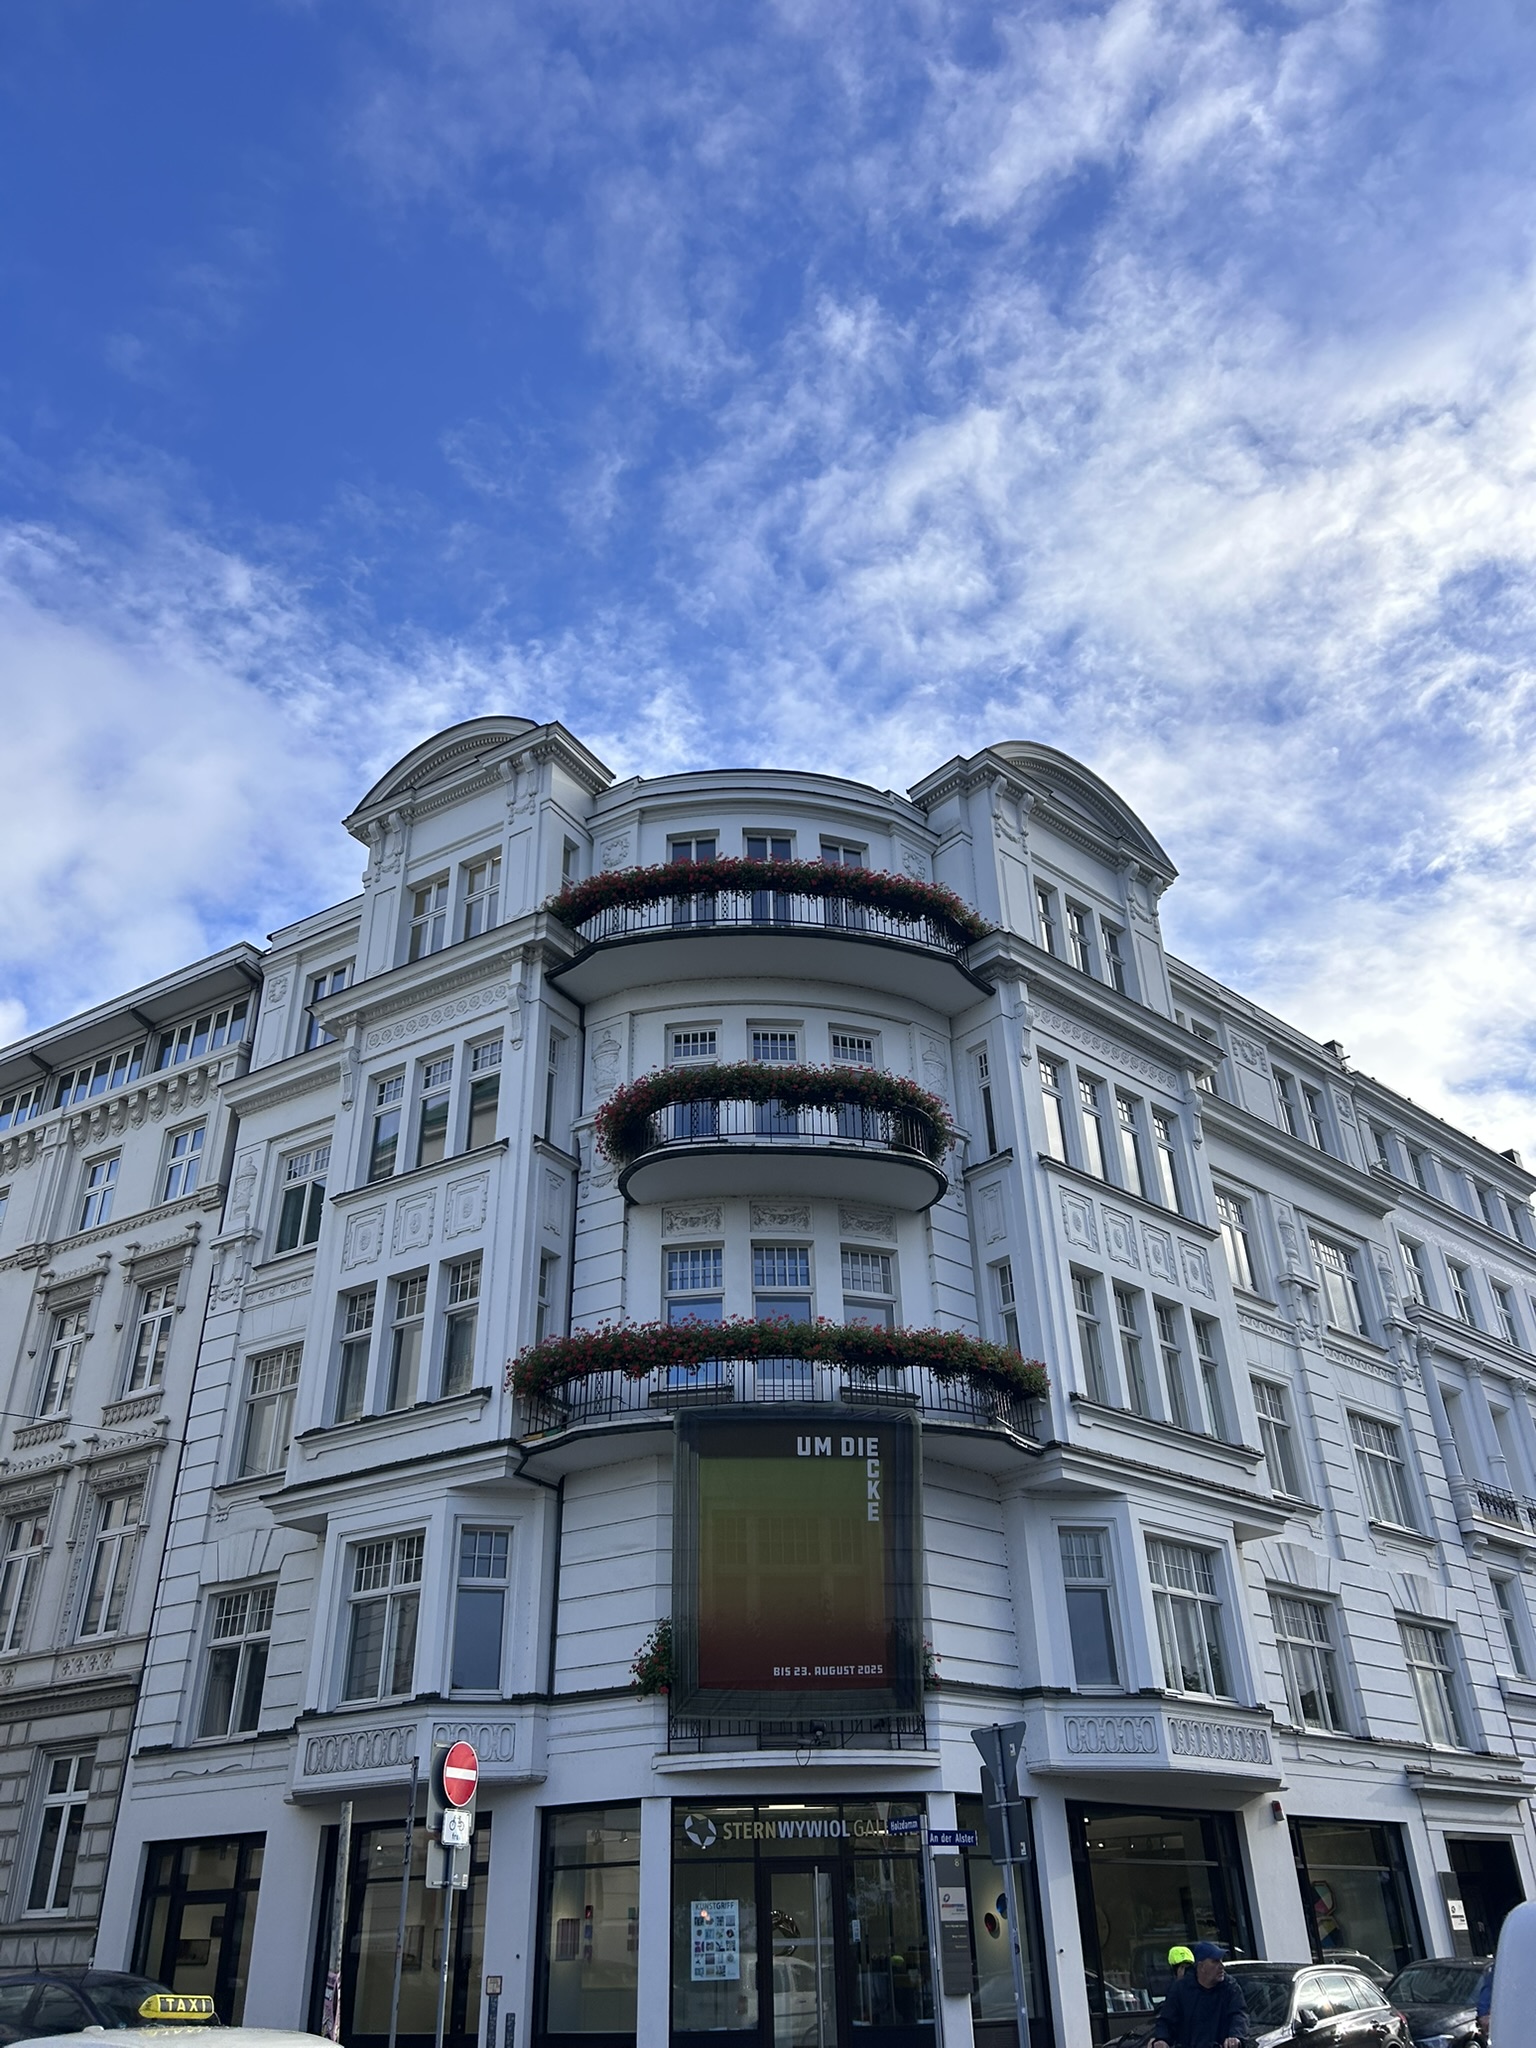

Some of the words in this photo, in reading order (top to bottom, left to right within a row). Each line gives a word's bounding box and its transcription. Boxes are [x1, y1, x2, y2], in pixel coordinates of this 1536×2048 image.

[797, 1436, 832, 1456] UM
[841, 1437, 879, 1457] DIE
[773, 1666, 791, 1677] BIS
[794, 1666, 812, 1676] 23.
[814, 1665, 855, 1676] AUGUST
[857, 1664, 883, 1675] 2025
[890, 1820, 919, 1832] Holzdamm
[929, 1832, 939, 1843] An
[940, 1833, 952, 1844] der
[955, 1833, 975, 1844] Alster
[695, 1901, 735, 1911] KUNSTGRIFF
[165, 1998, 207, 2012] TAXI
